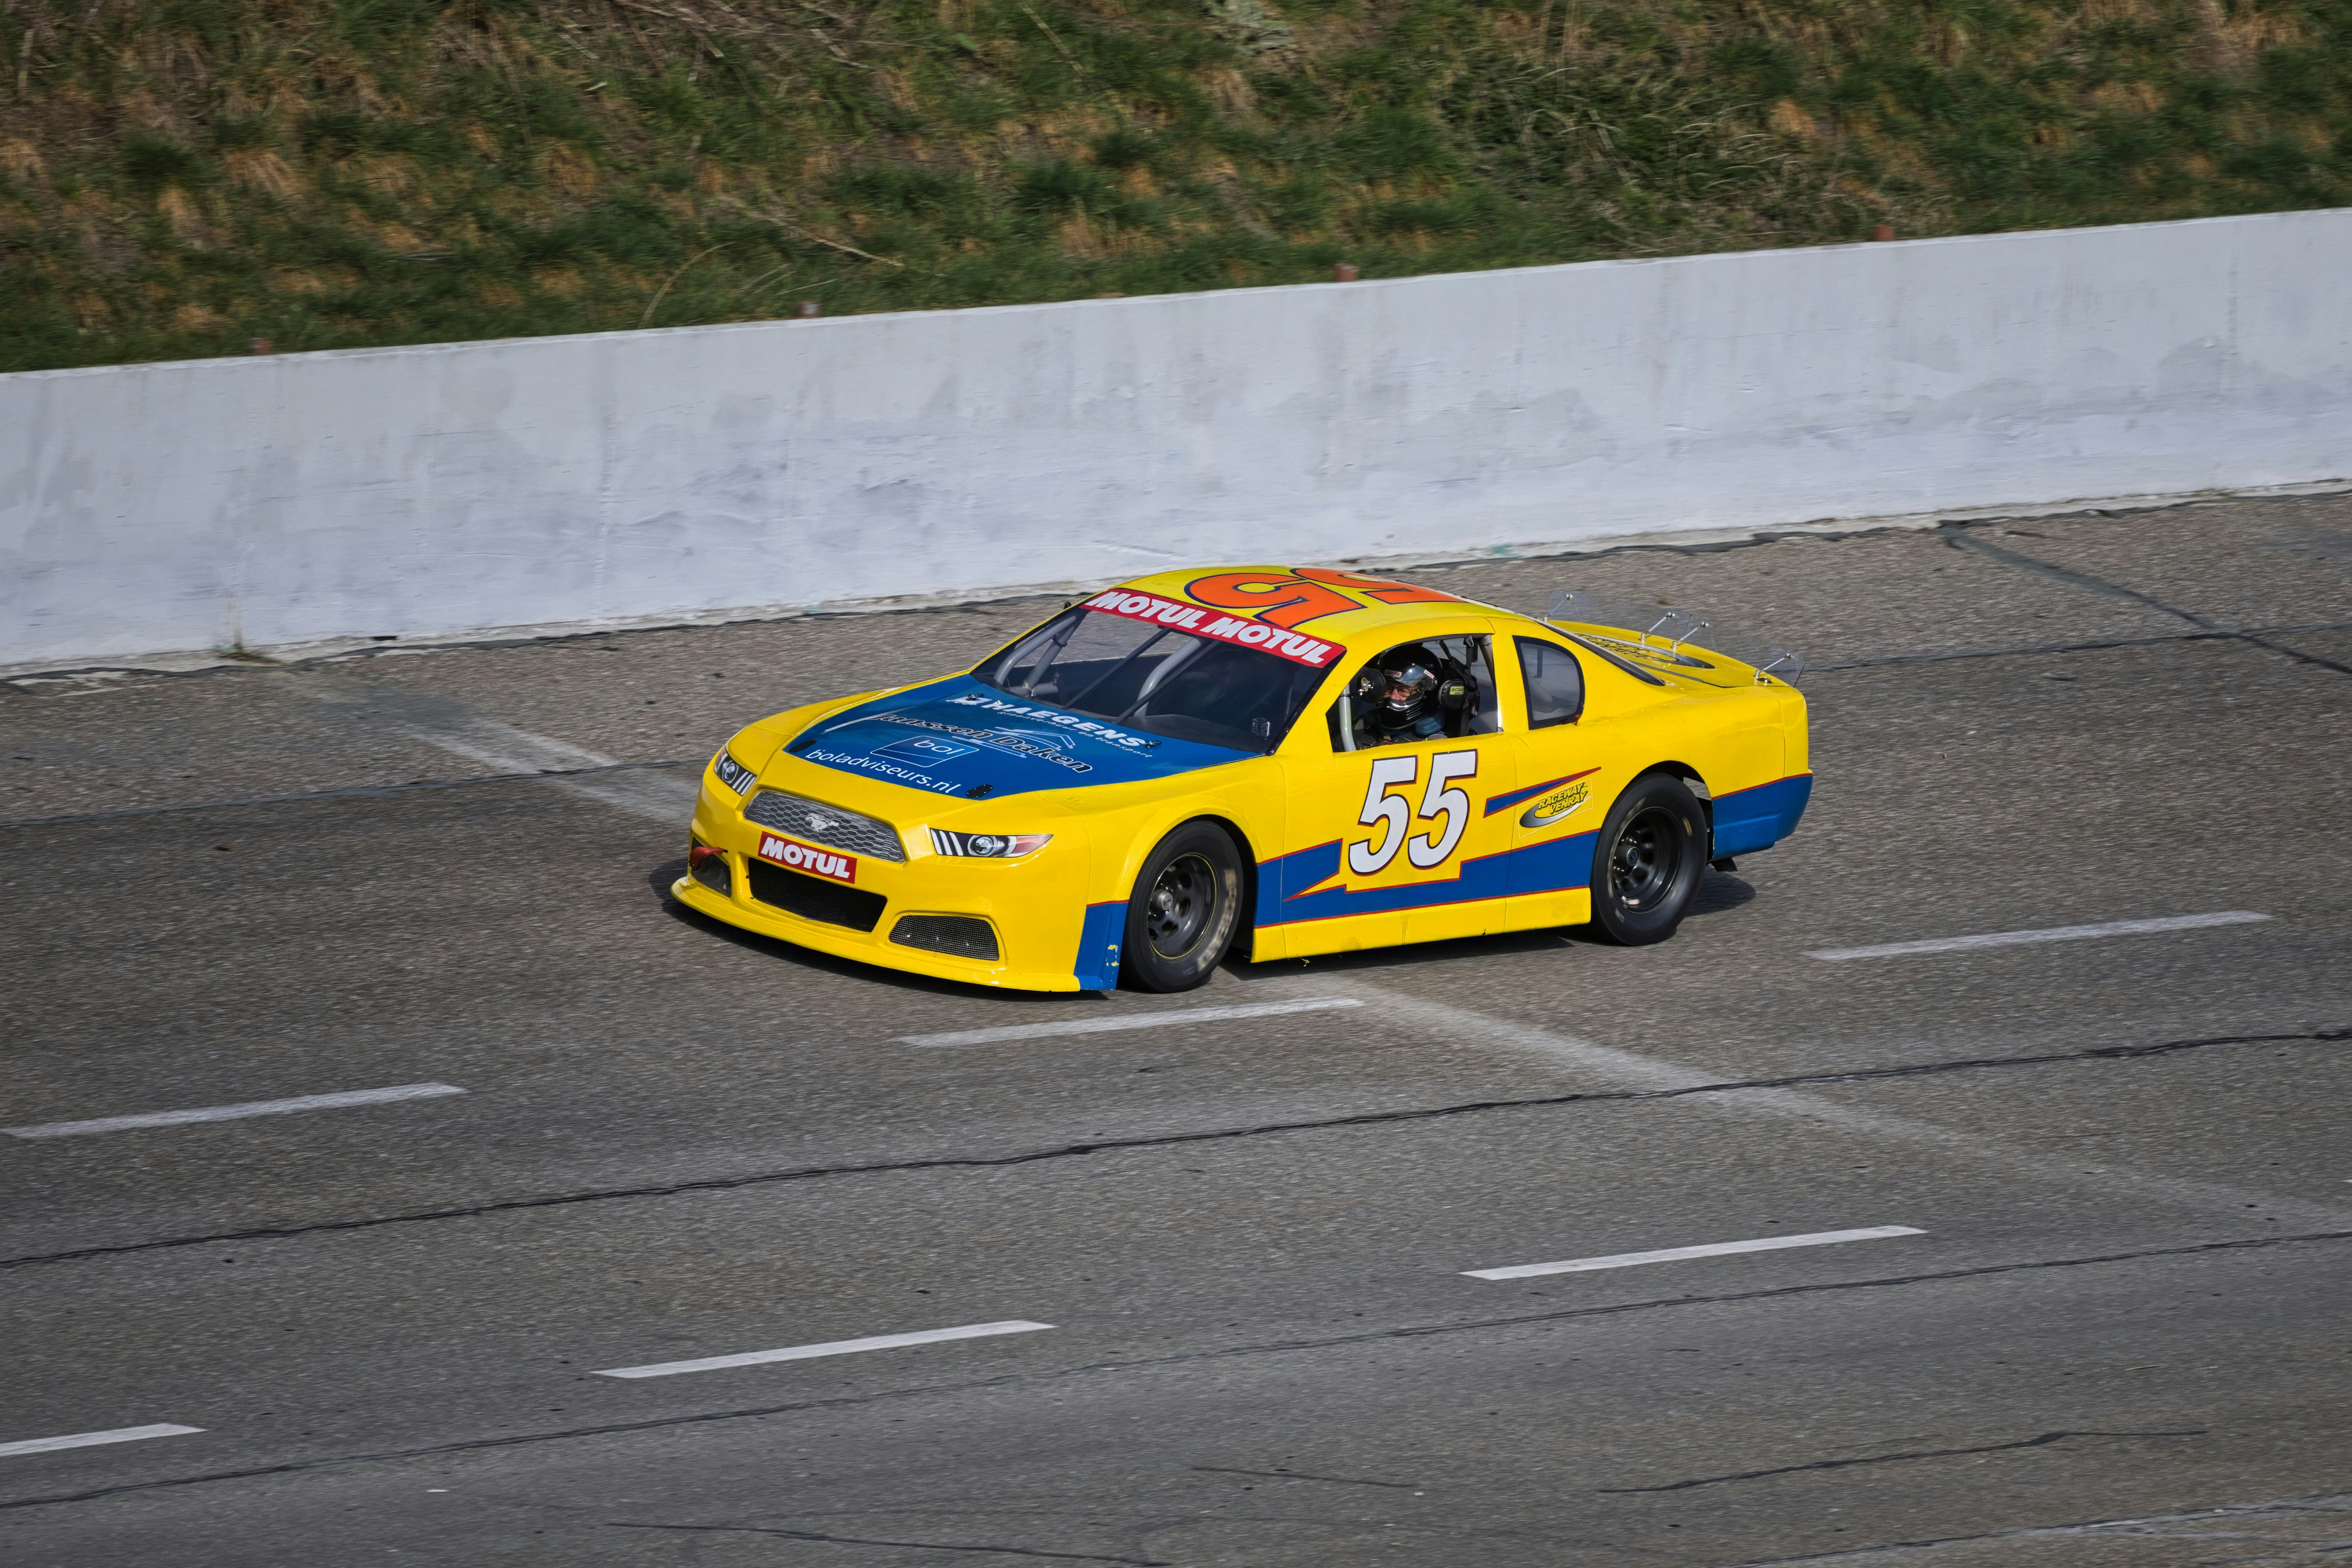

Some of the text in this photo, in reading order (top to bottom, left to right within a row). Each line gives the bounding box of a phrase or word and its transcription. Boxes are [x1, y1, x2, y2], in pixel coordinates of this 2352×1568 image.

[1087, 592, 1332, 664] MOTUL MOTUL
[868, 714, 1093, 773] Janssen Daken
[981, 700, 1146, 746] HAEGENS
[914, 740, 965, 754] bol
[805, 749, 961, 793] boladviseurs.nl
[1349, 748, 1478, 877] 55
[1538, 782, 1588, 810] RACEWAY
[1550, 790, 1588, 815] VENRAY
[760, 837, 850, 879] MOTUL
